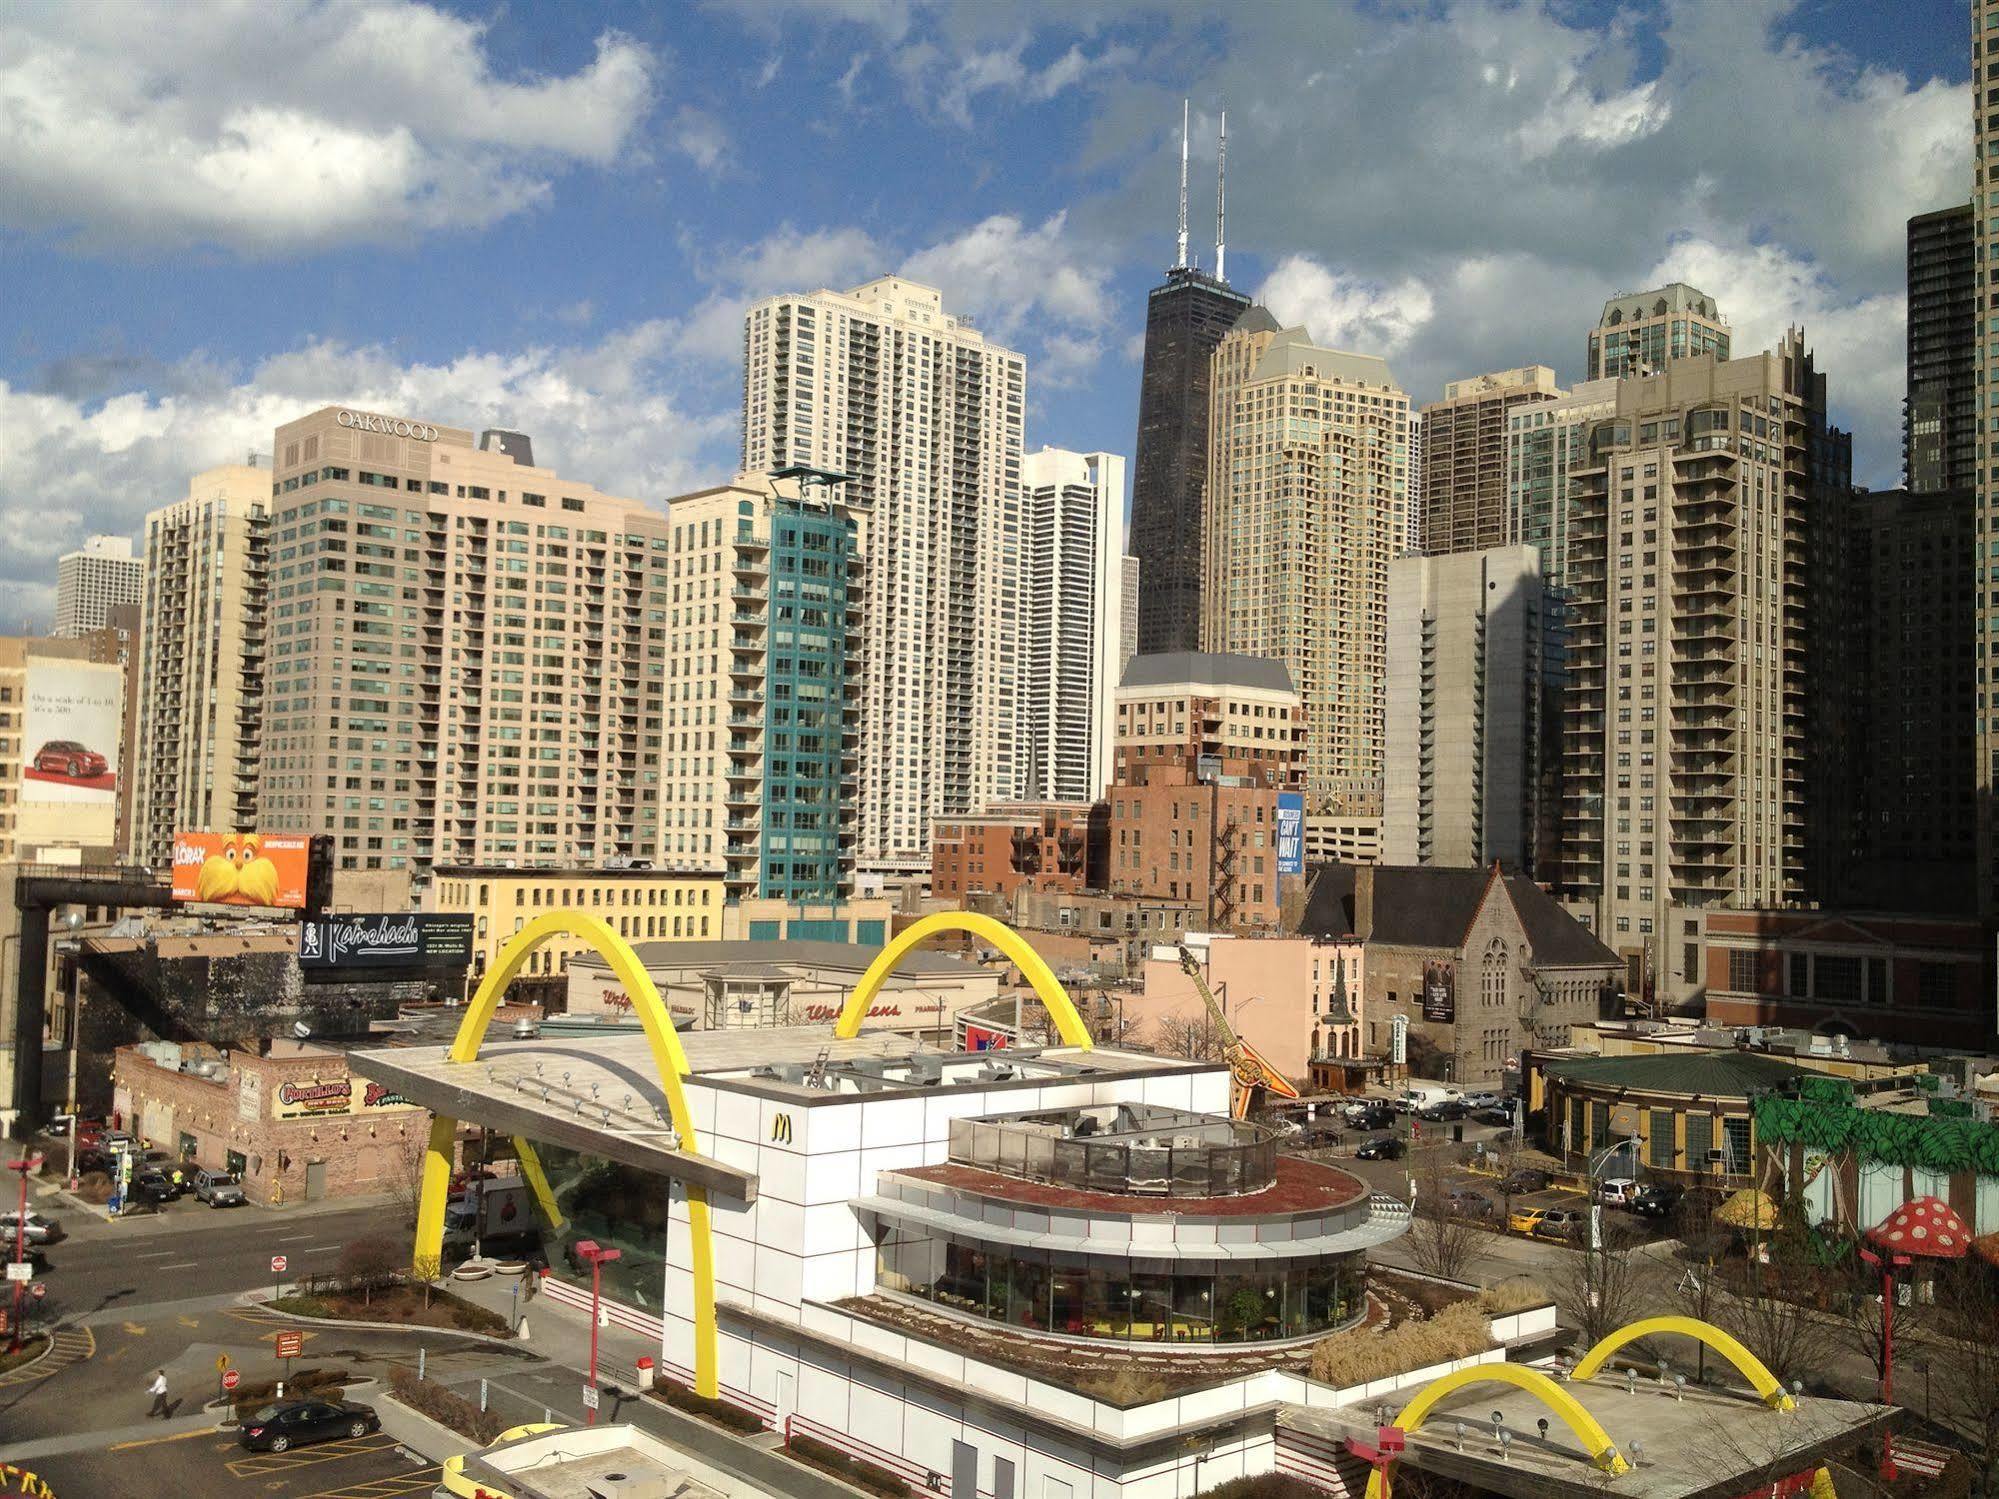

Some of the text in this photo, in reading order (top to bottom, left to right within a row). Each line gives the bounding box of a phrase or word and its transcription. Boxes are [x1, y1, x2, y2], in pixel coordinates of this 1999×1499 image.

[337, 410, 438, 442] OAKWOOD
[32, 693, 46, 702] On
[1280, 820, 1299, 836] CAN'T
[174, 845, 206, 865] LORAX
[1279, 837, 1299, 858] WAIT
[172, 888, 191, 897] MARCH
[329, 915, 419, 963] Kamehachi
[806, 1004, 902, 1021] Walens
[382, 1095, 404, 1104] PASTA
[224, 1375, 240, 1384] STOP
